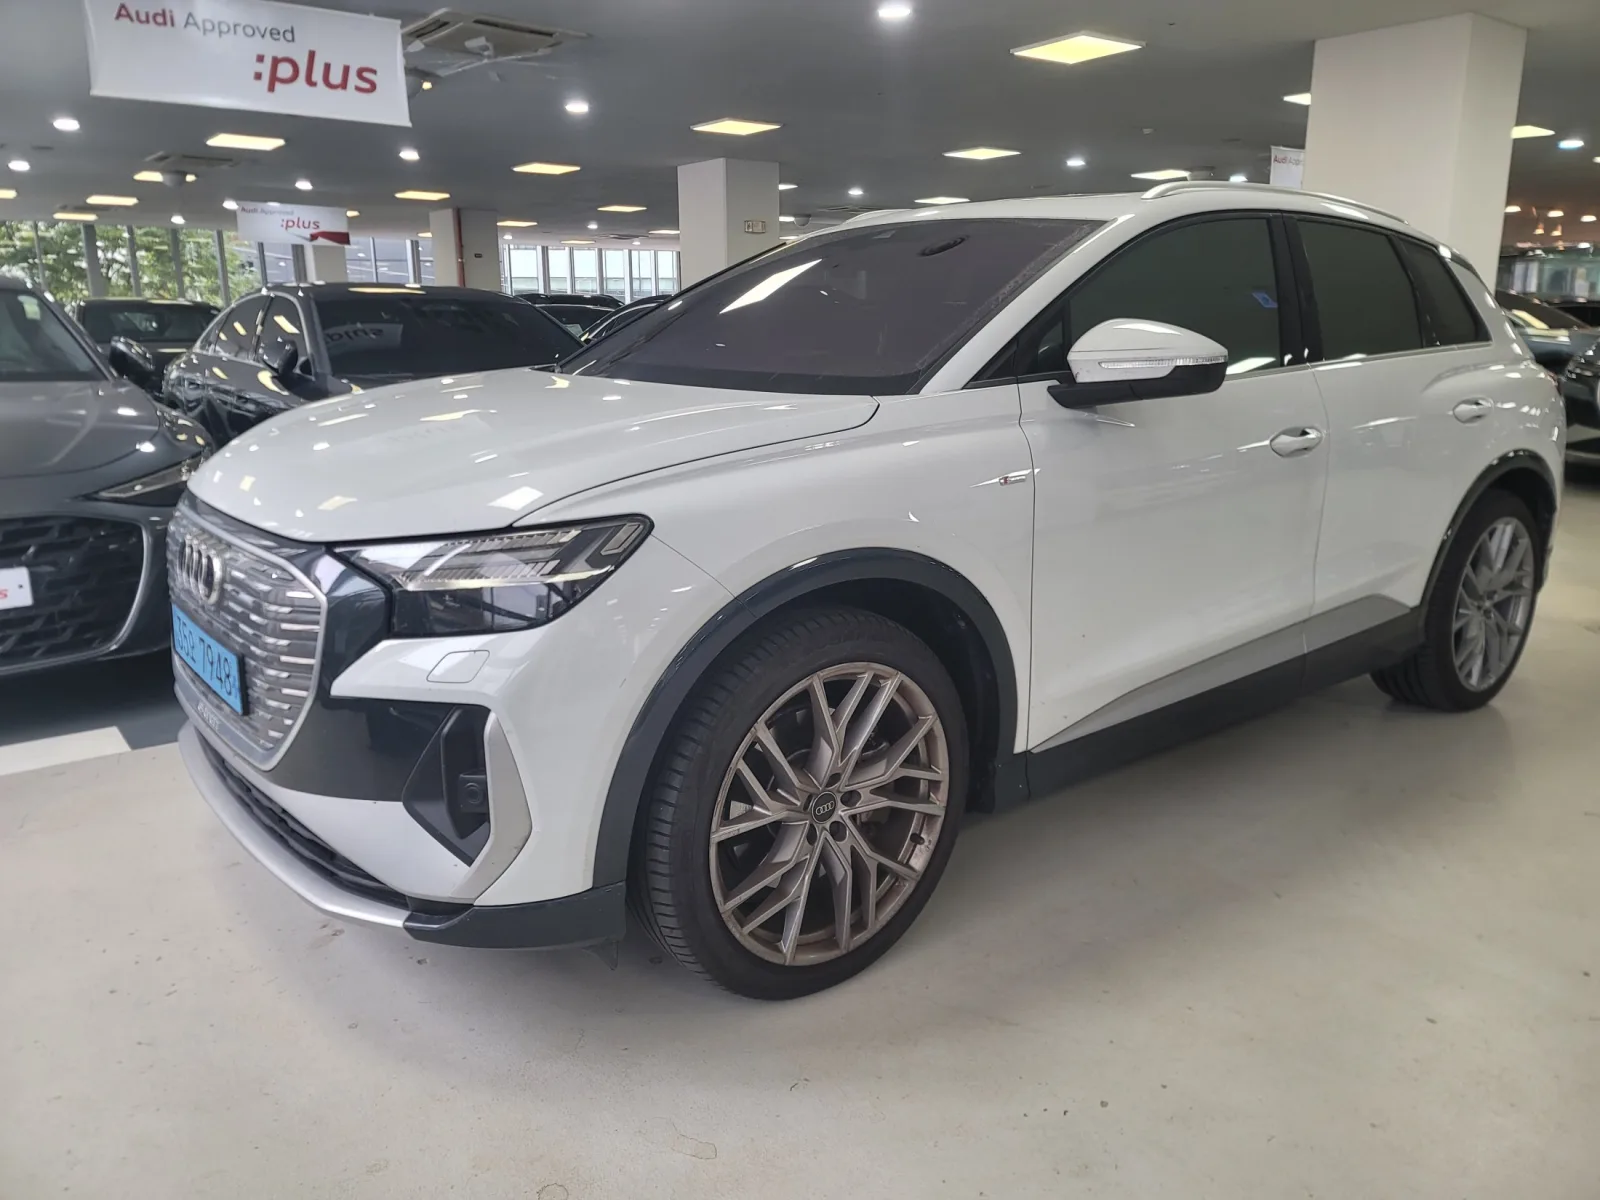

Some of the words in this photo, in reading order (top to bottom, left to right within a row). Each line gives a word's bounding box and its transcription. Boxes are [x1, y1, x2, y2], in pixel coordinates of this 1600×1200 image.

[114, 2, 175, 28] Audi
[184, 12, 295, 43] Approved
[253, 49, 377, 94] :plus
[240, 206, 258, 215] Audi
[199, 636, 232, 696] 7948
